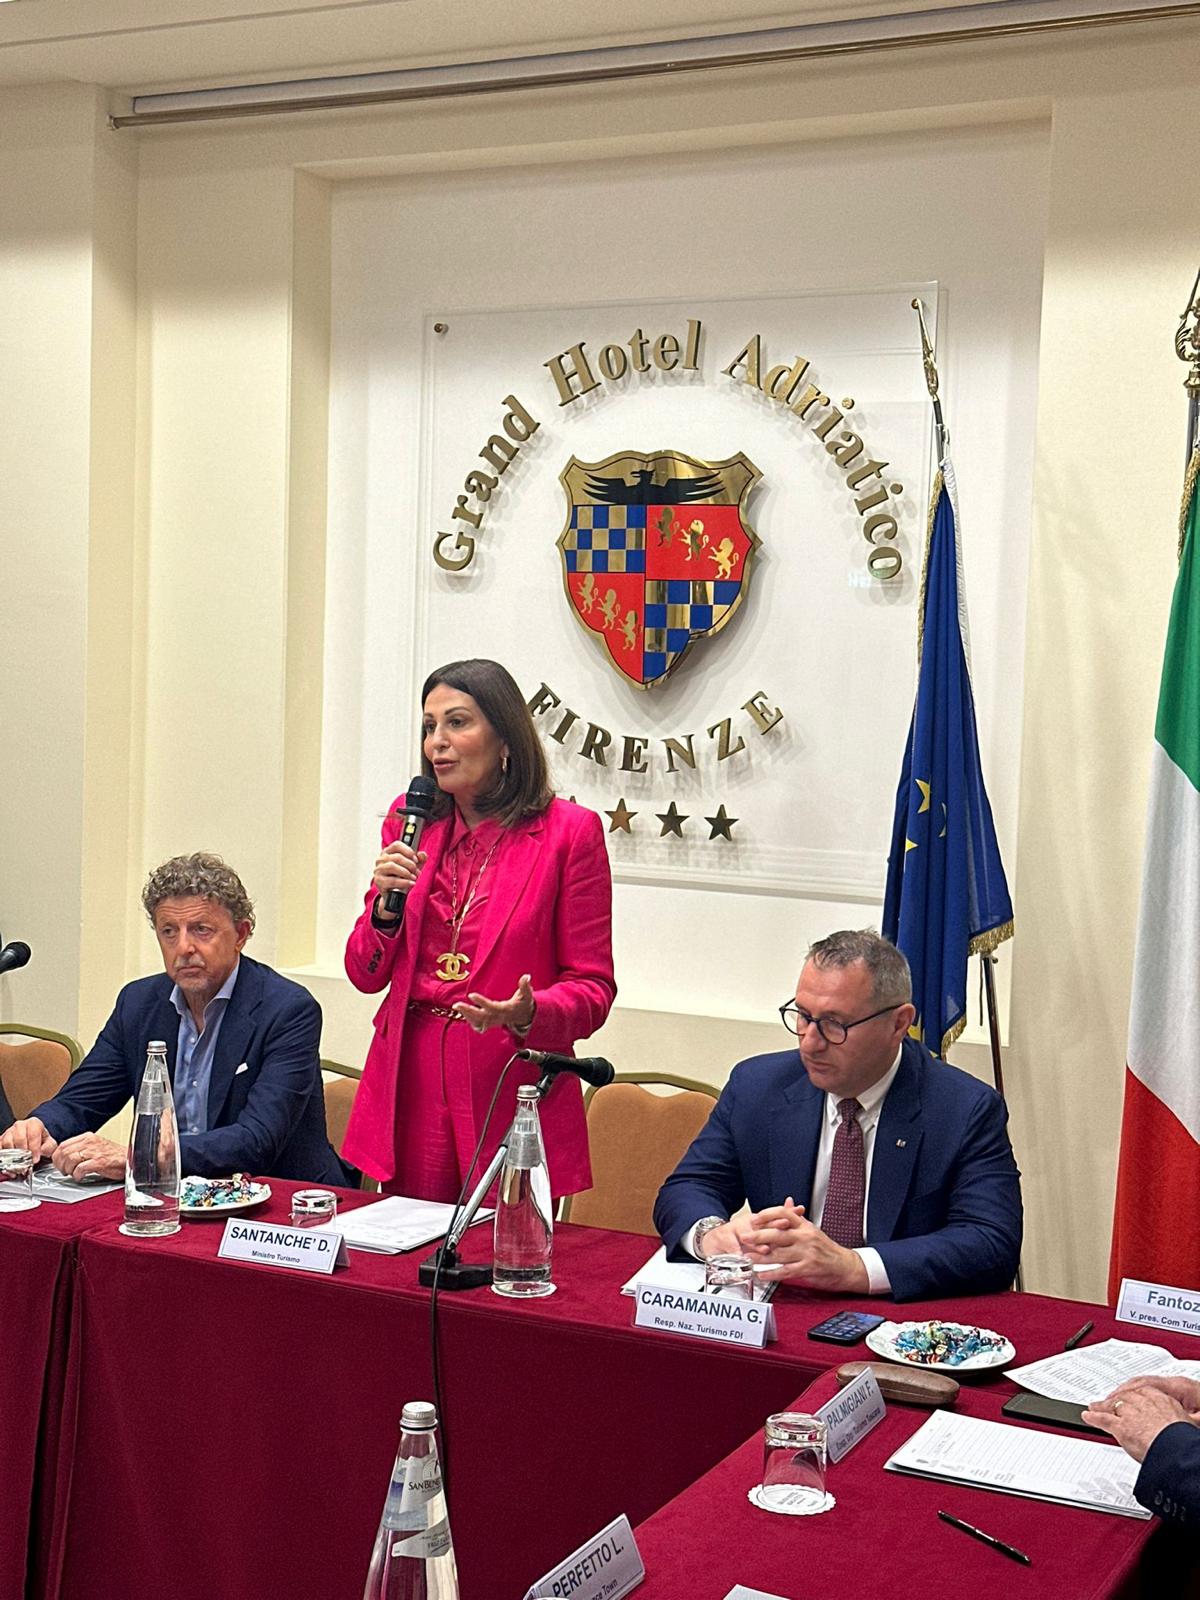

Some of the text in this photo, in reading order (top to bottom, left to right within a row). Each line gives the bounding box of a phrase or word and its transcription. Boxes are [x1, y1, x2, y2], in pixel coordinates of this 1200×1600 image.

[433, 319, 904, 579] Grand Hotel Adriatico
[527, 682, 784, 773] FIRENZE
[251, 1250, 301, 1263] Ministro Turismo
[317, 1239, 331, 1253] D.
[641, 1290, 762, 1324] CARAMANNA G.
[1129, 1310, 1137, 1319] V.
[1138, 1313, 1159, 1323] pres.
[1161, 1316, 1180, 1327] Com
[654, 1316, 744, 1340] Resp. Naz. Turismo FDI
[826, 1380, 875, 1430] PALMIGIANI F.
[552, 1537, 625, 1598] PERFETTO L.
[602, 1579, 618, 1596] Town
